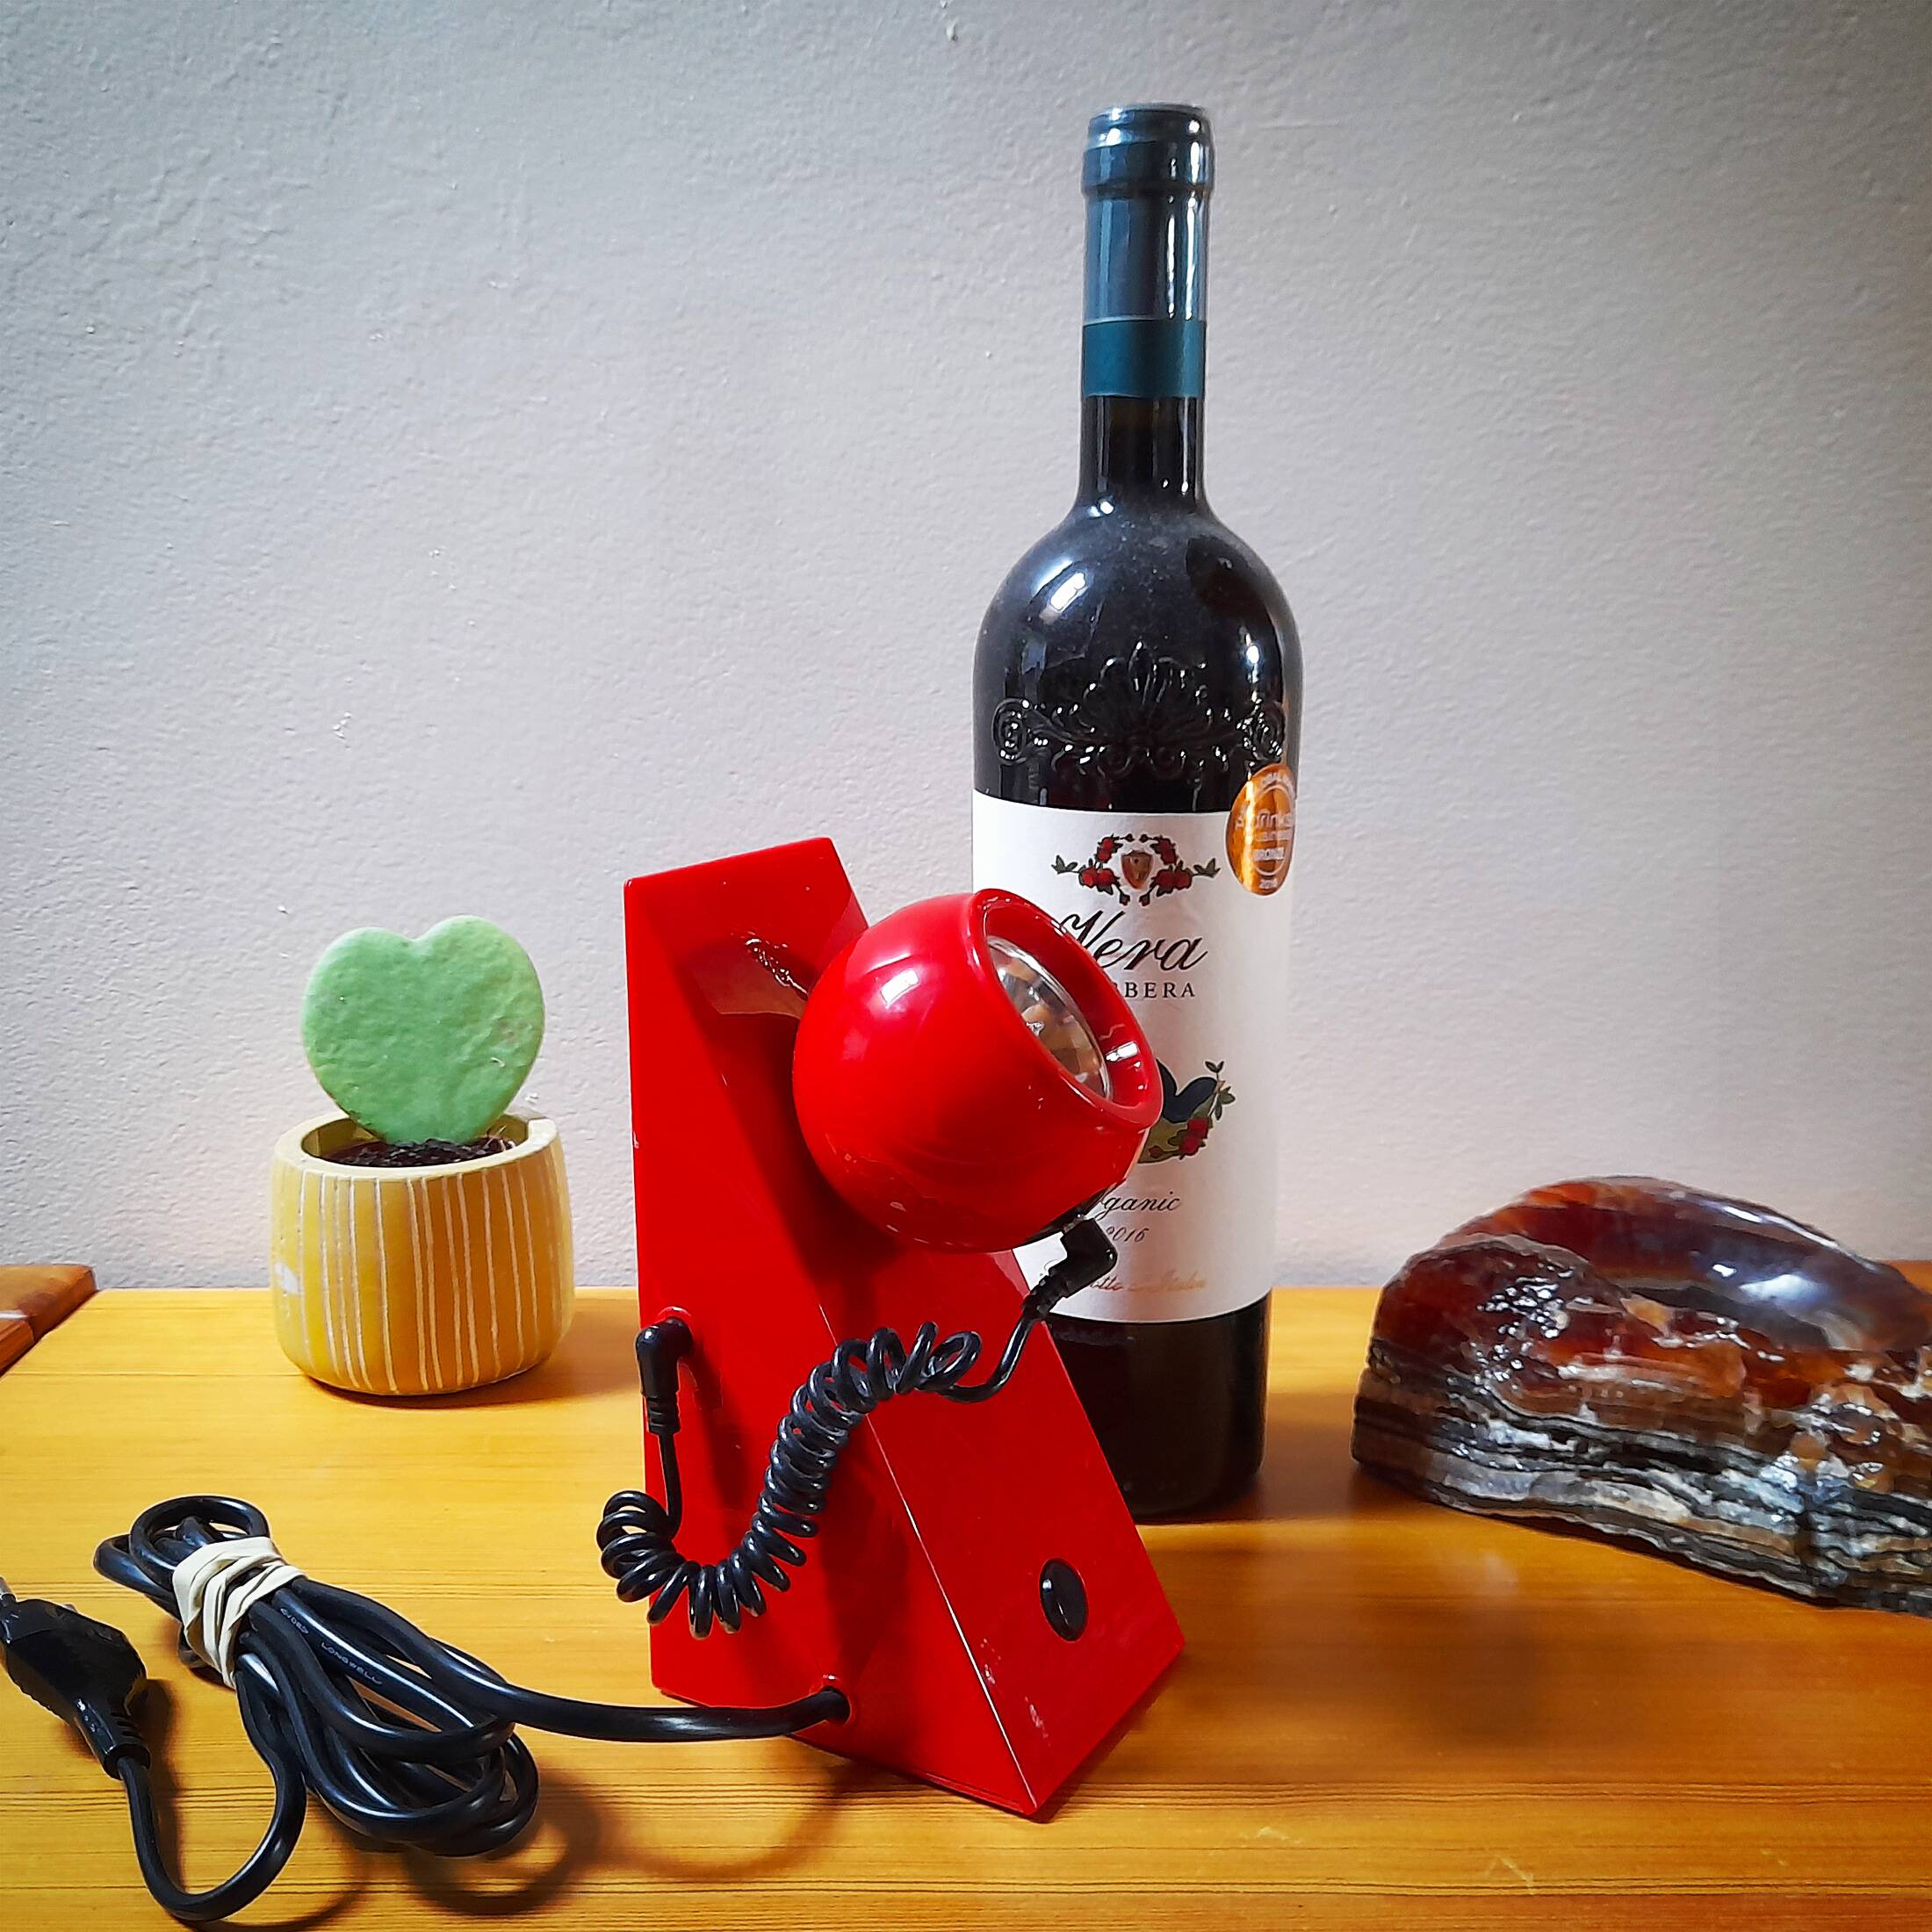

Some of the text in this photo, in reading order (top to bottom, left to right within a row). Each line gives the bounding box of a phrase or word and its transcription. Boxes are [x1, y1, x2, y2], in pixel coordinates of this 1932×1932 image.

[1115, 981, 1196, 999] BERA
[1093, 1191, 1180, 1221] ganic
[321, 1641, 382, 1684] LONGWELL
